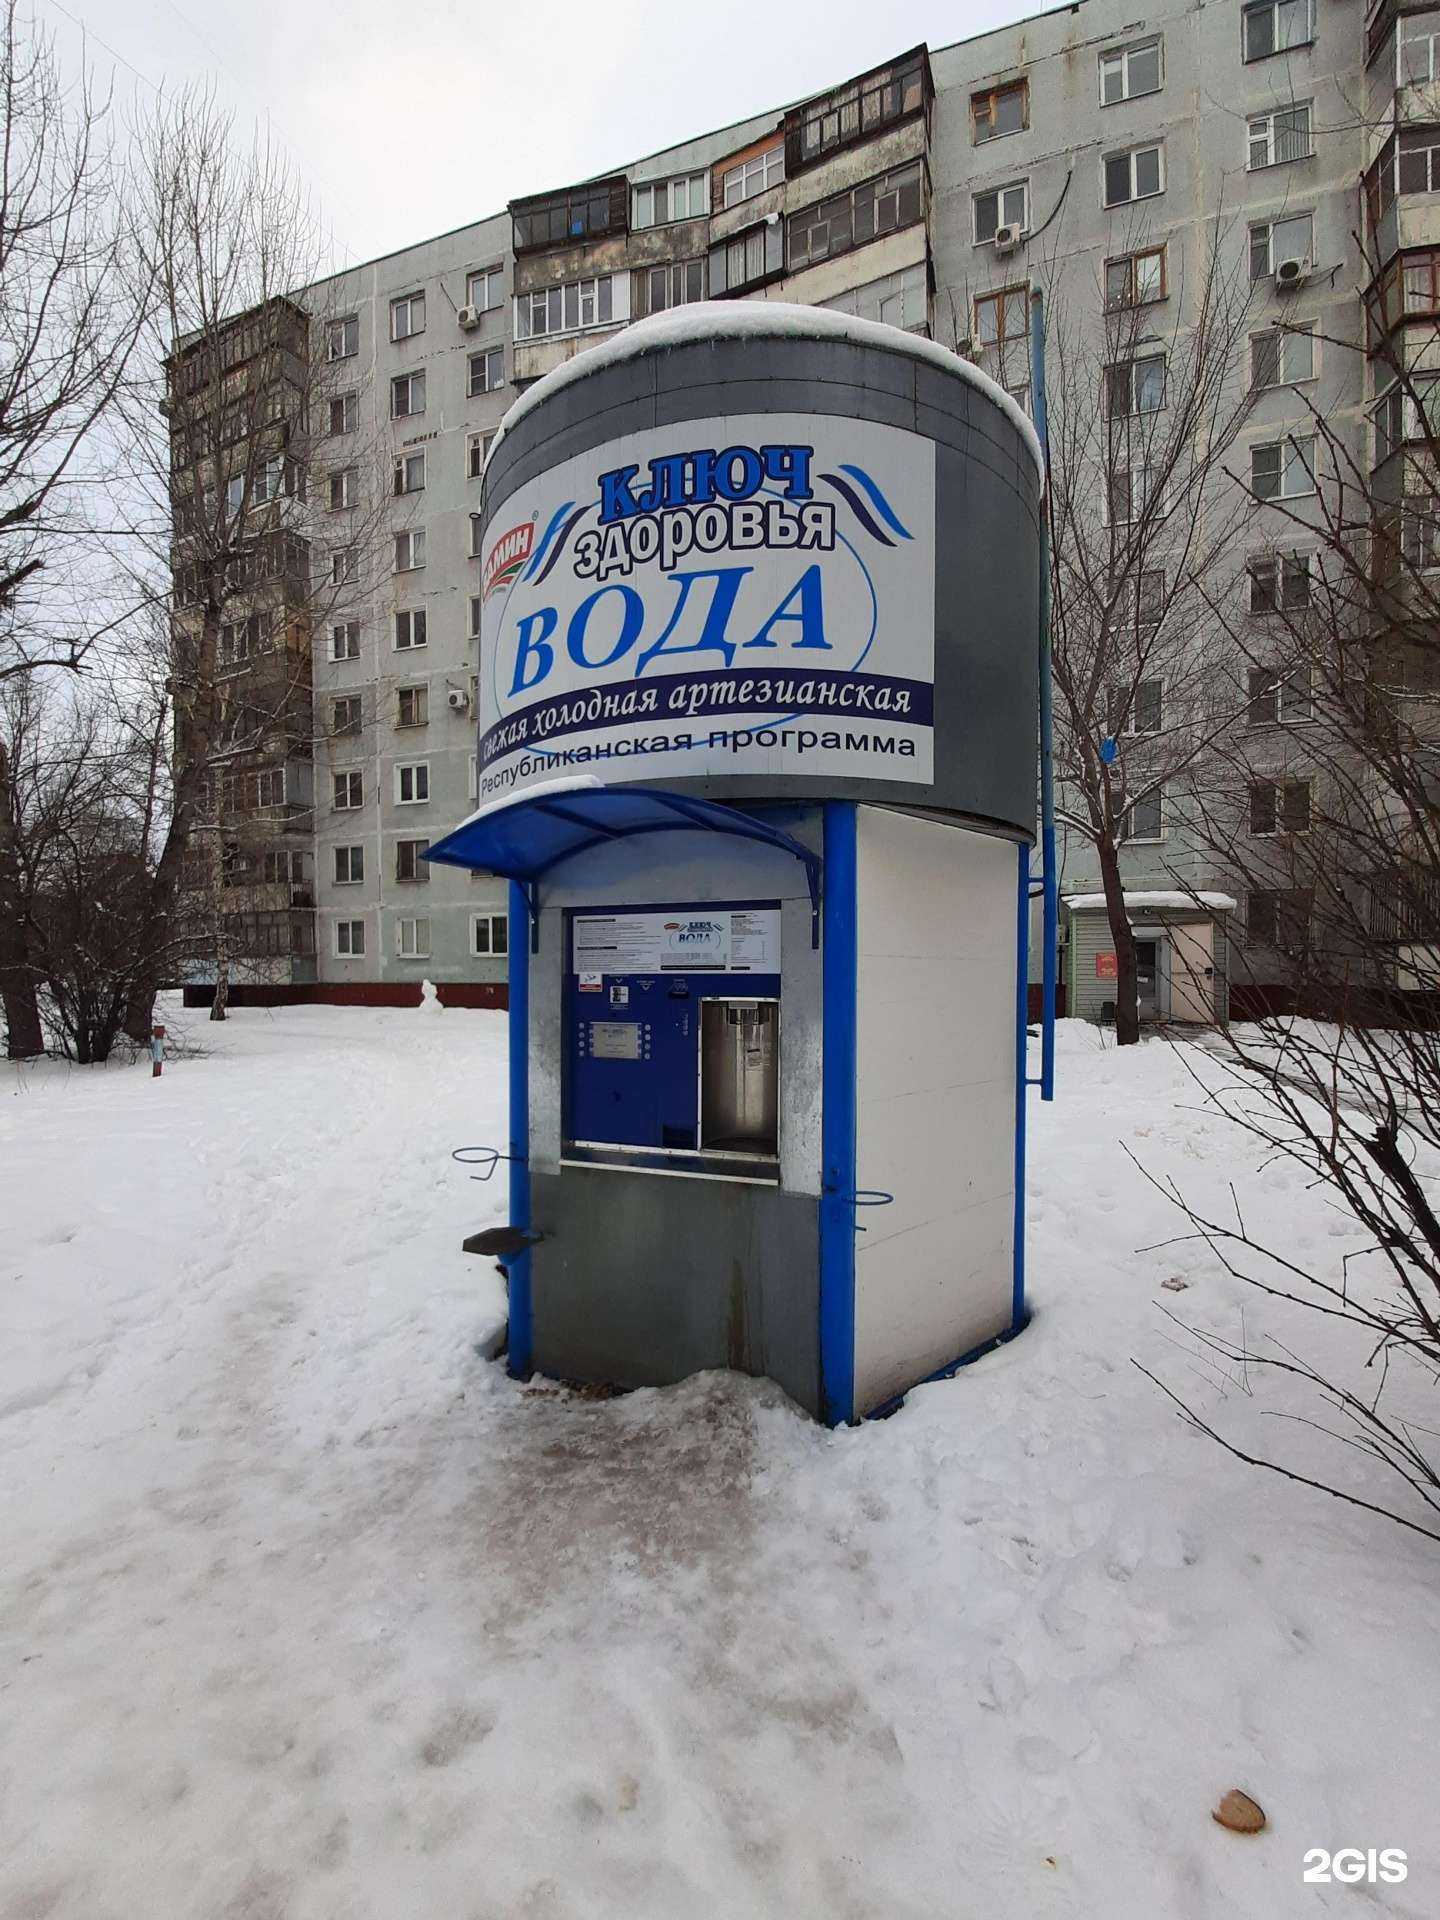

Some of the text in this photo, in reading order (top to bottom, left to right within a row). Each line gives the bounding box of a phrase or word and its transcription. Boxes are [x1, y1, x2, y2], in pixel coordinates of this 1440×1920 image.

[595, 445, 815, 525] КЛЮЧ
[507, 564, 833, 699] ВОДА
[482, 678, 912, 763] свежая холодная артезианская
[480, 728, 916, 797] Республиканская программа
